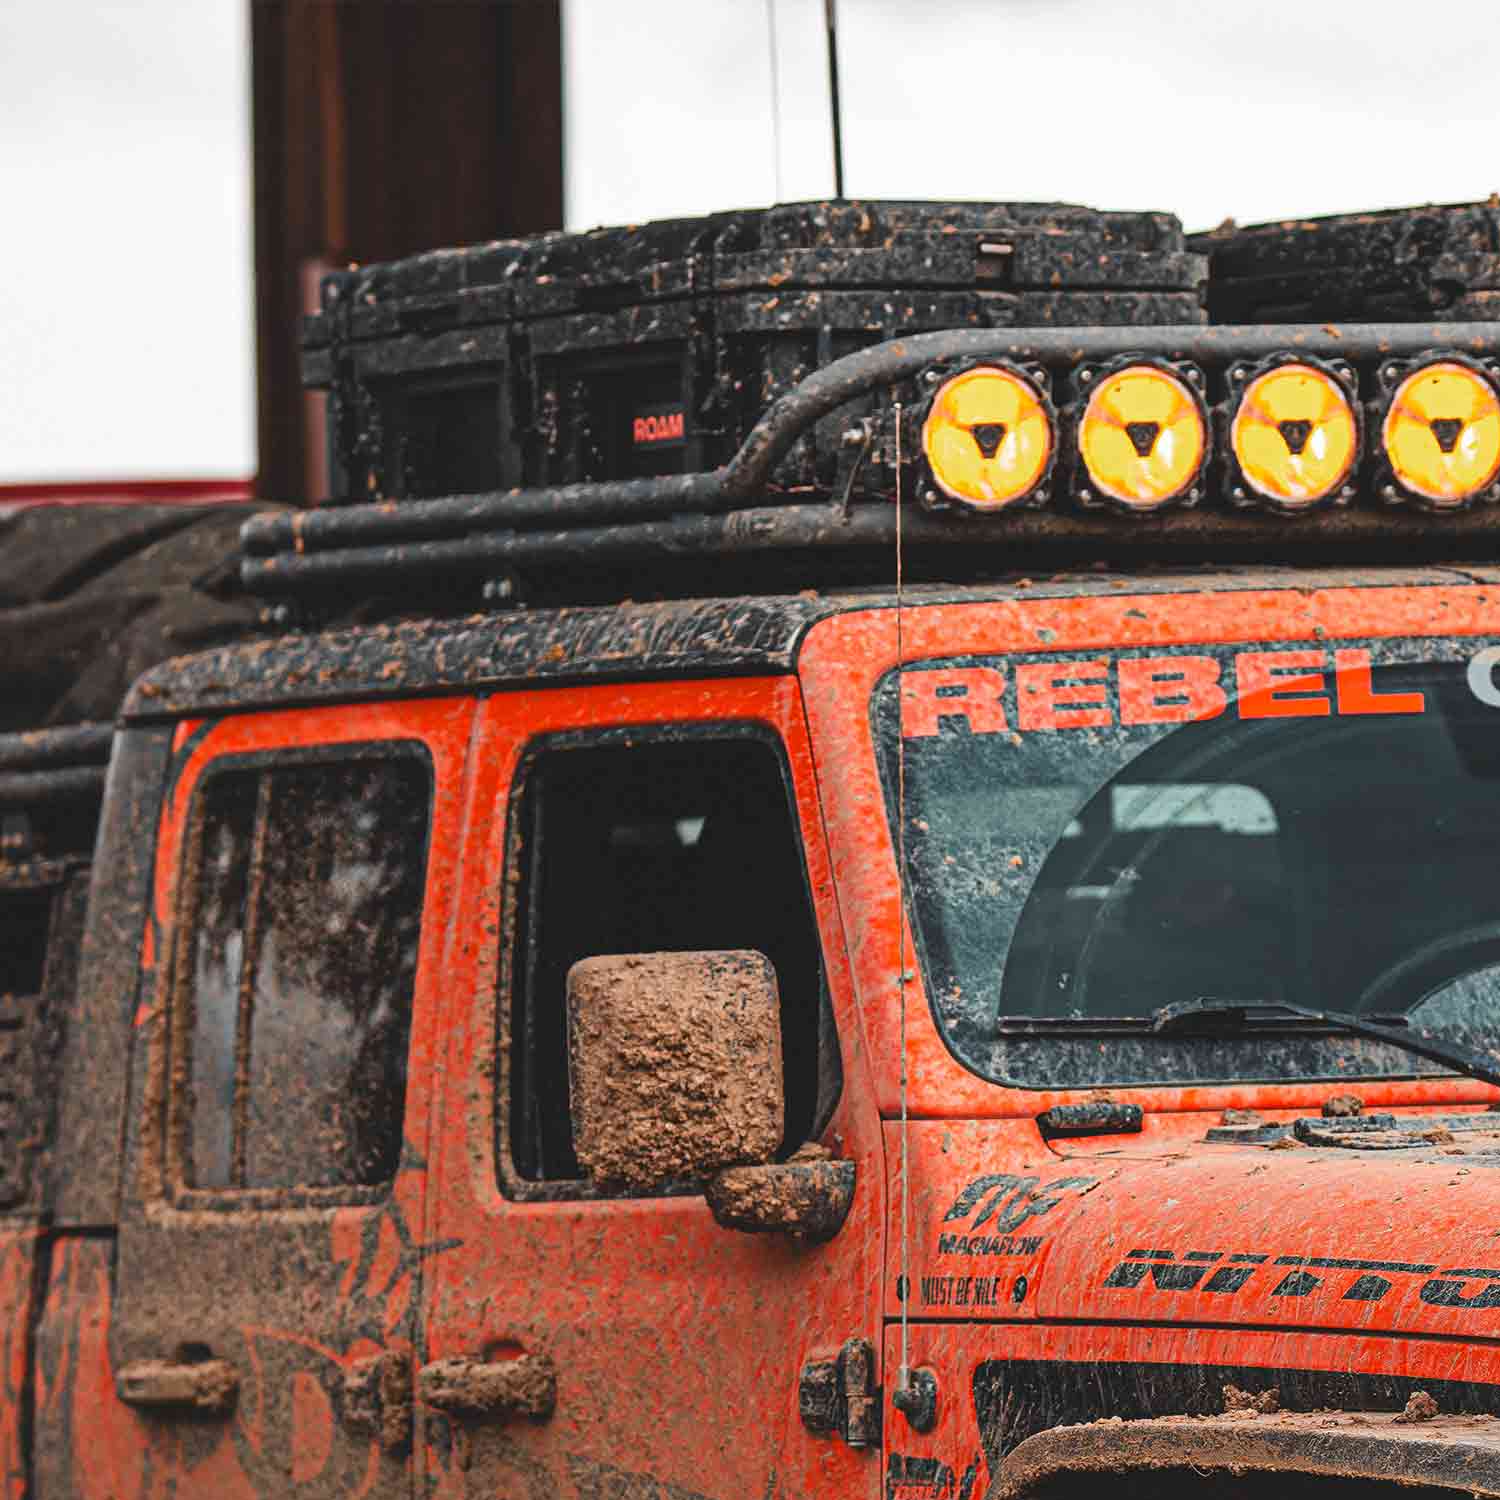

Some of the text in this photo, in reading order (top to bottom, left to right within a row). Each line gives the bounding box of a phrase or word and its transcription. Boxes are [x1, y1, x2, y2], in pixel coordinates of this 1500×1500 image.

[633, 412, 684, 444] ROAM
[901, 649, 1425, 738] REBEL
[920, 1276, 954, 1305] MUST
[955, 1276, 973, 1305] BE
